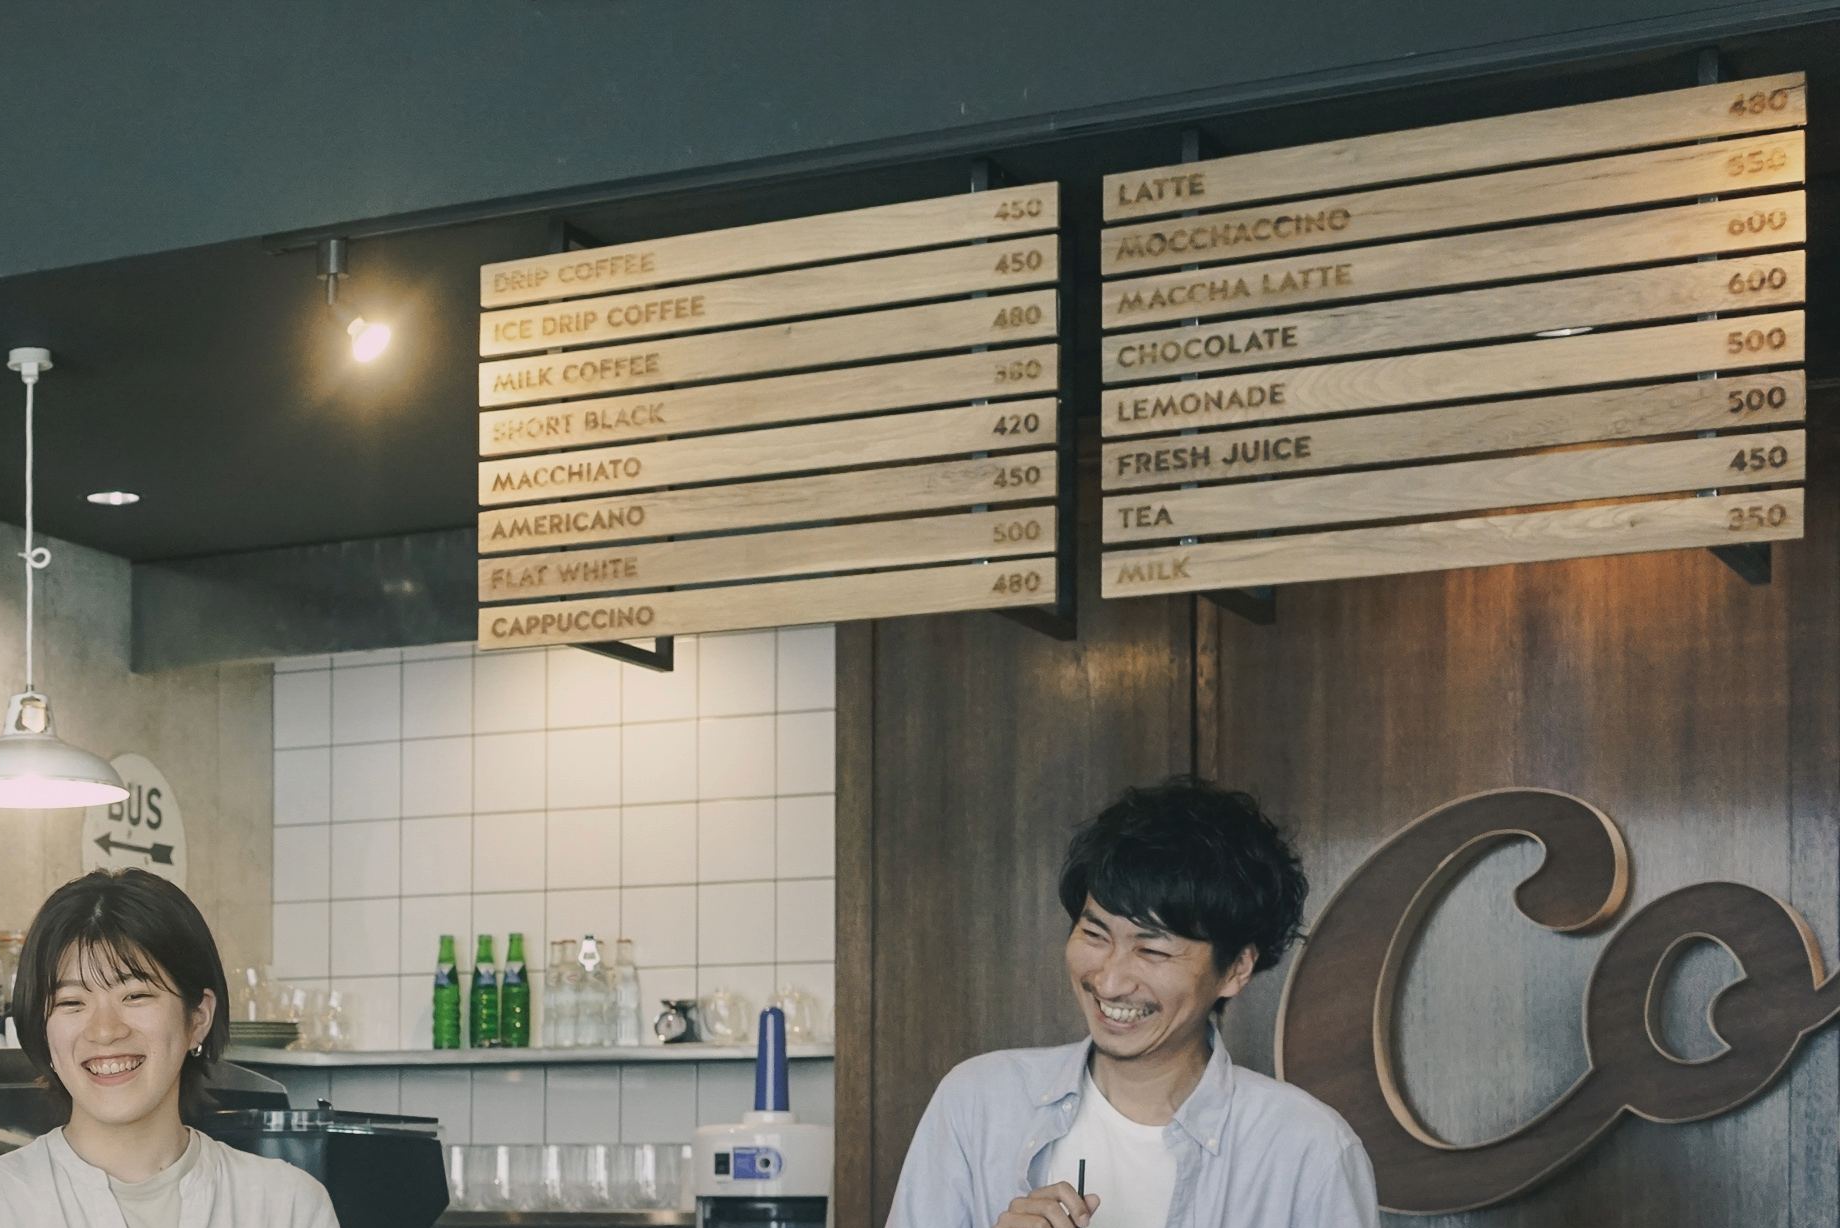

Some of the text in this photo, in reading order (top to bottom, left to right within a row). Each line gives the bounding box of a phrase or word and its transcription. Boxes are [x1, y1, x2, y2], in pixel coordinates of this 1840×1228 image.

[1119, 88, 1788, 206] LATTE 480
[493, 199, 1042, 293] DRIP COFFEE 450
[1116, 208, 1351, 261] MOCCHACCINO
[1118, 209, 1787, 314] MACCHA LATTE 600
[494, 250, 1042, 342] ICE DRIP COFFEE 450
[1118, 267, 1787, 368] CHOCOLATE 600
[493, 304, 1042, 392] MILK COFFEE 480
[1117, 327, 1787, 424] LEMONADE 500
[492, 413, 1040, 492] MACCHIATO 420
[493, 413, 574, 442] SHORT
[585, 403, 666, 431] BLACK
[1117, 385, 1787, 476] FRESH JUICE 500
[490, 466, 1041, 541] AMERICANO 450
[1117, 447, 1788, 530] TEA 450
[490, 522, 1041, 590] FLAT WHITE 500
[1116, 505, 1787, 585] MILK 350
[491, 571, 1041, 638] CAPPUCCINO 480
